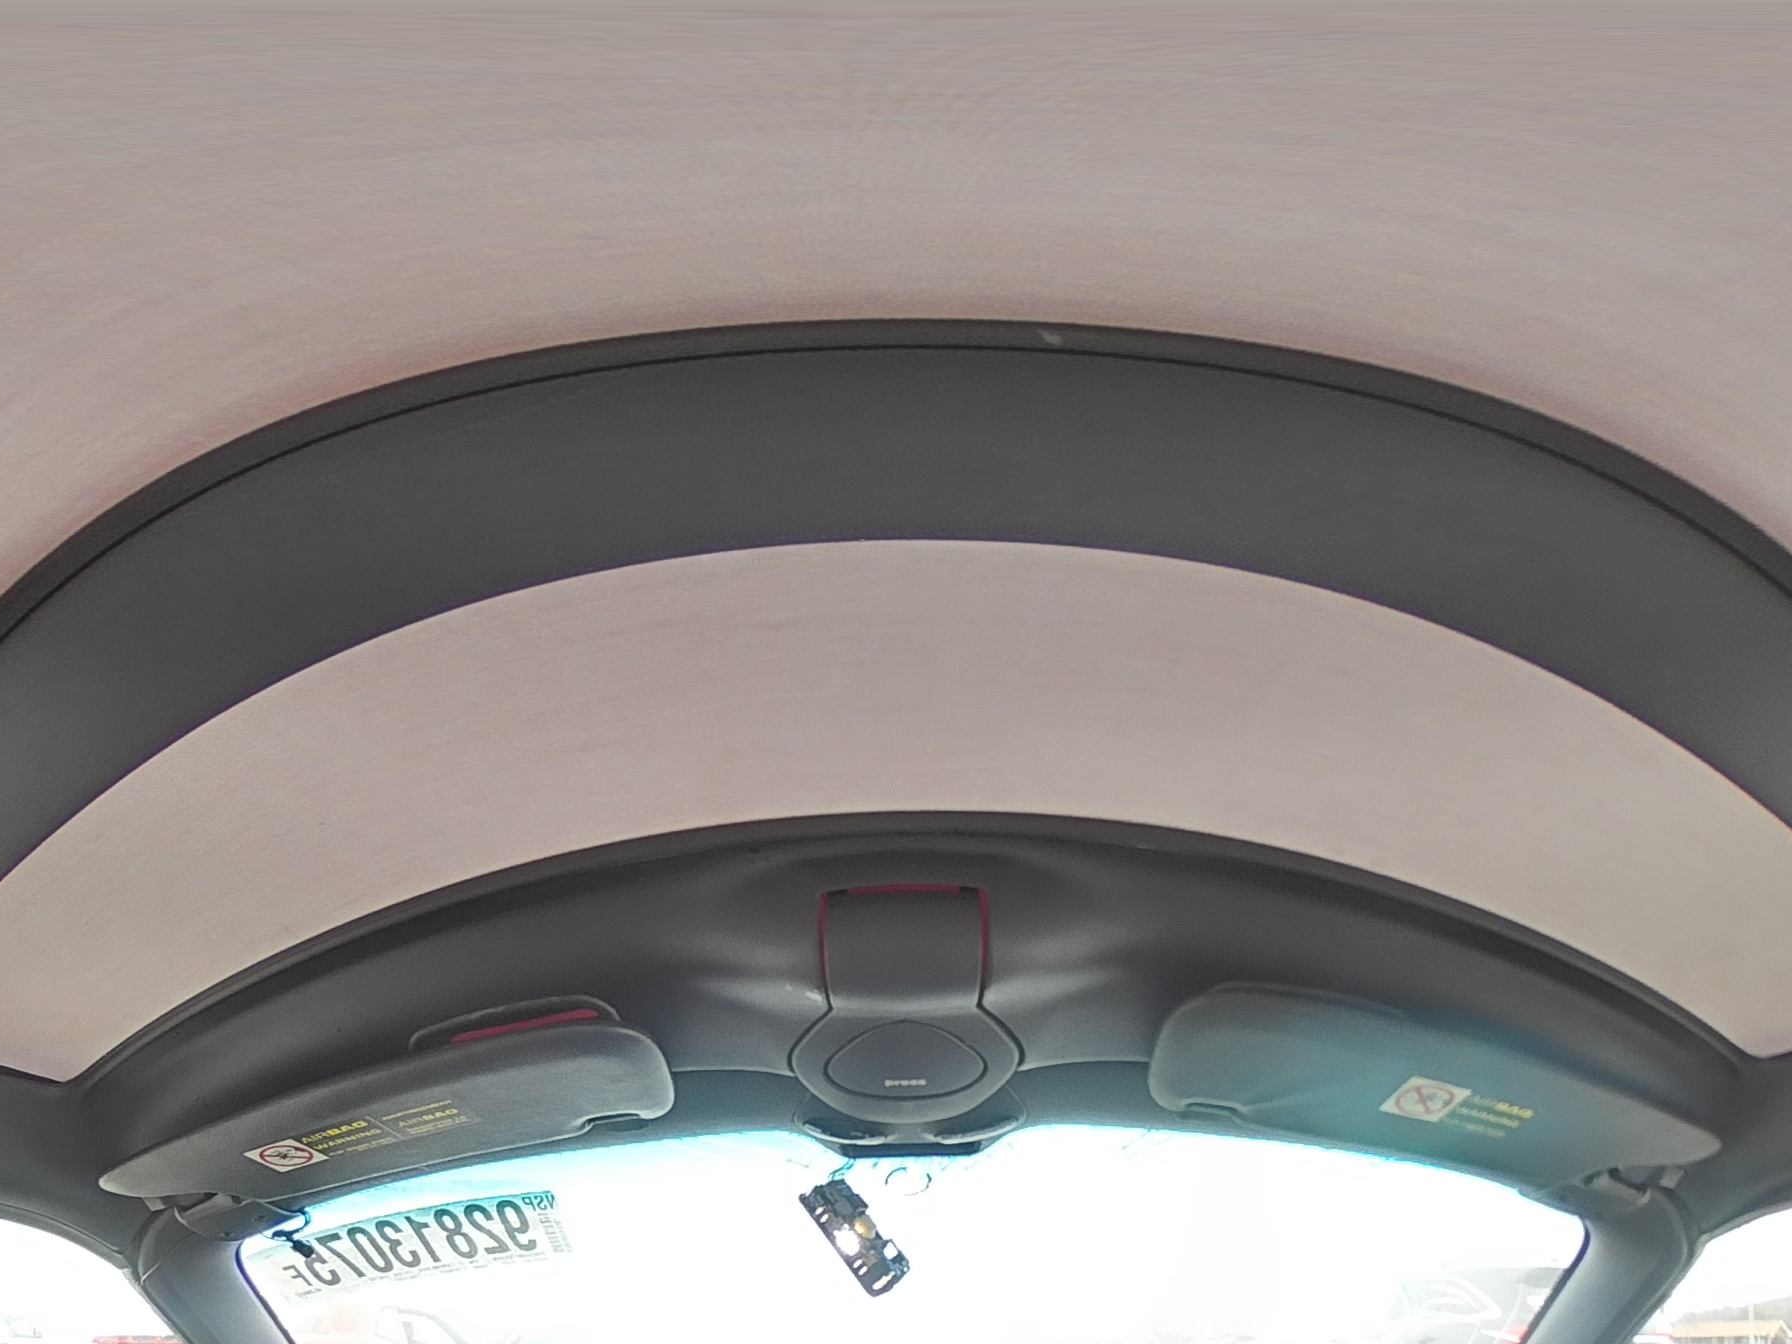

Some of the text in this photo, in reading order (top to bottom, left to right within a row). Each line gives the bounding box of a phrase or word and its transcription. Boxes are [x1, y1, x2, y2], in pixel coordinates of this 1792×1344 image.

[396, 1107, 459, 1129] AIRBAG
[299, 1119, 369, 1145] AIRBAG
[311, 1128, 382, 1151] WARNING
